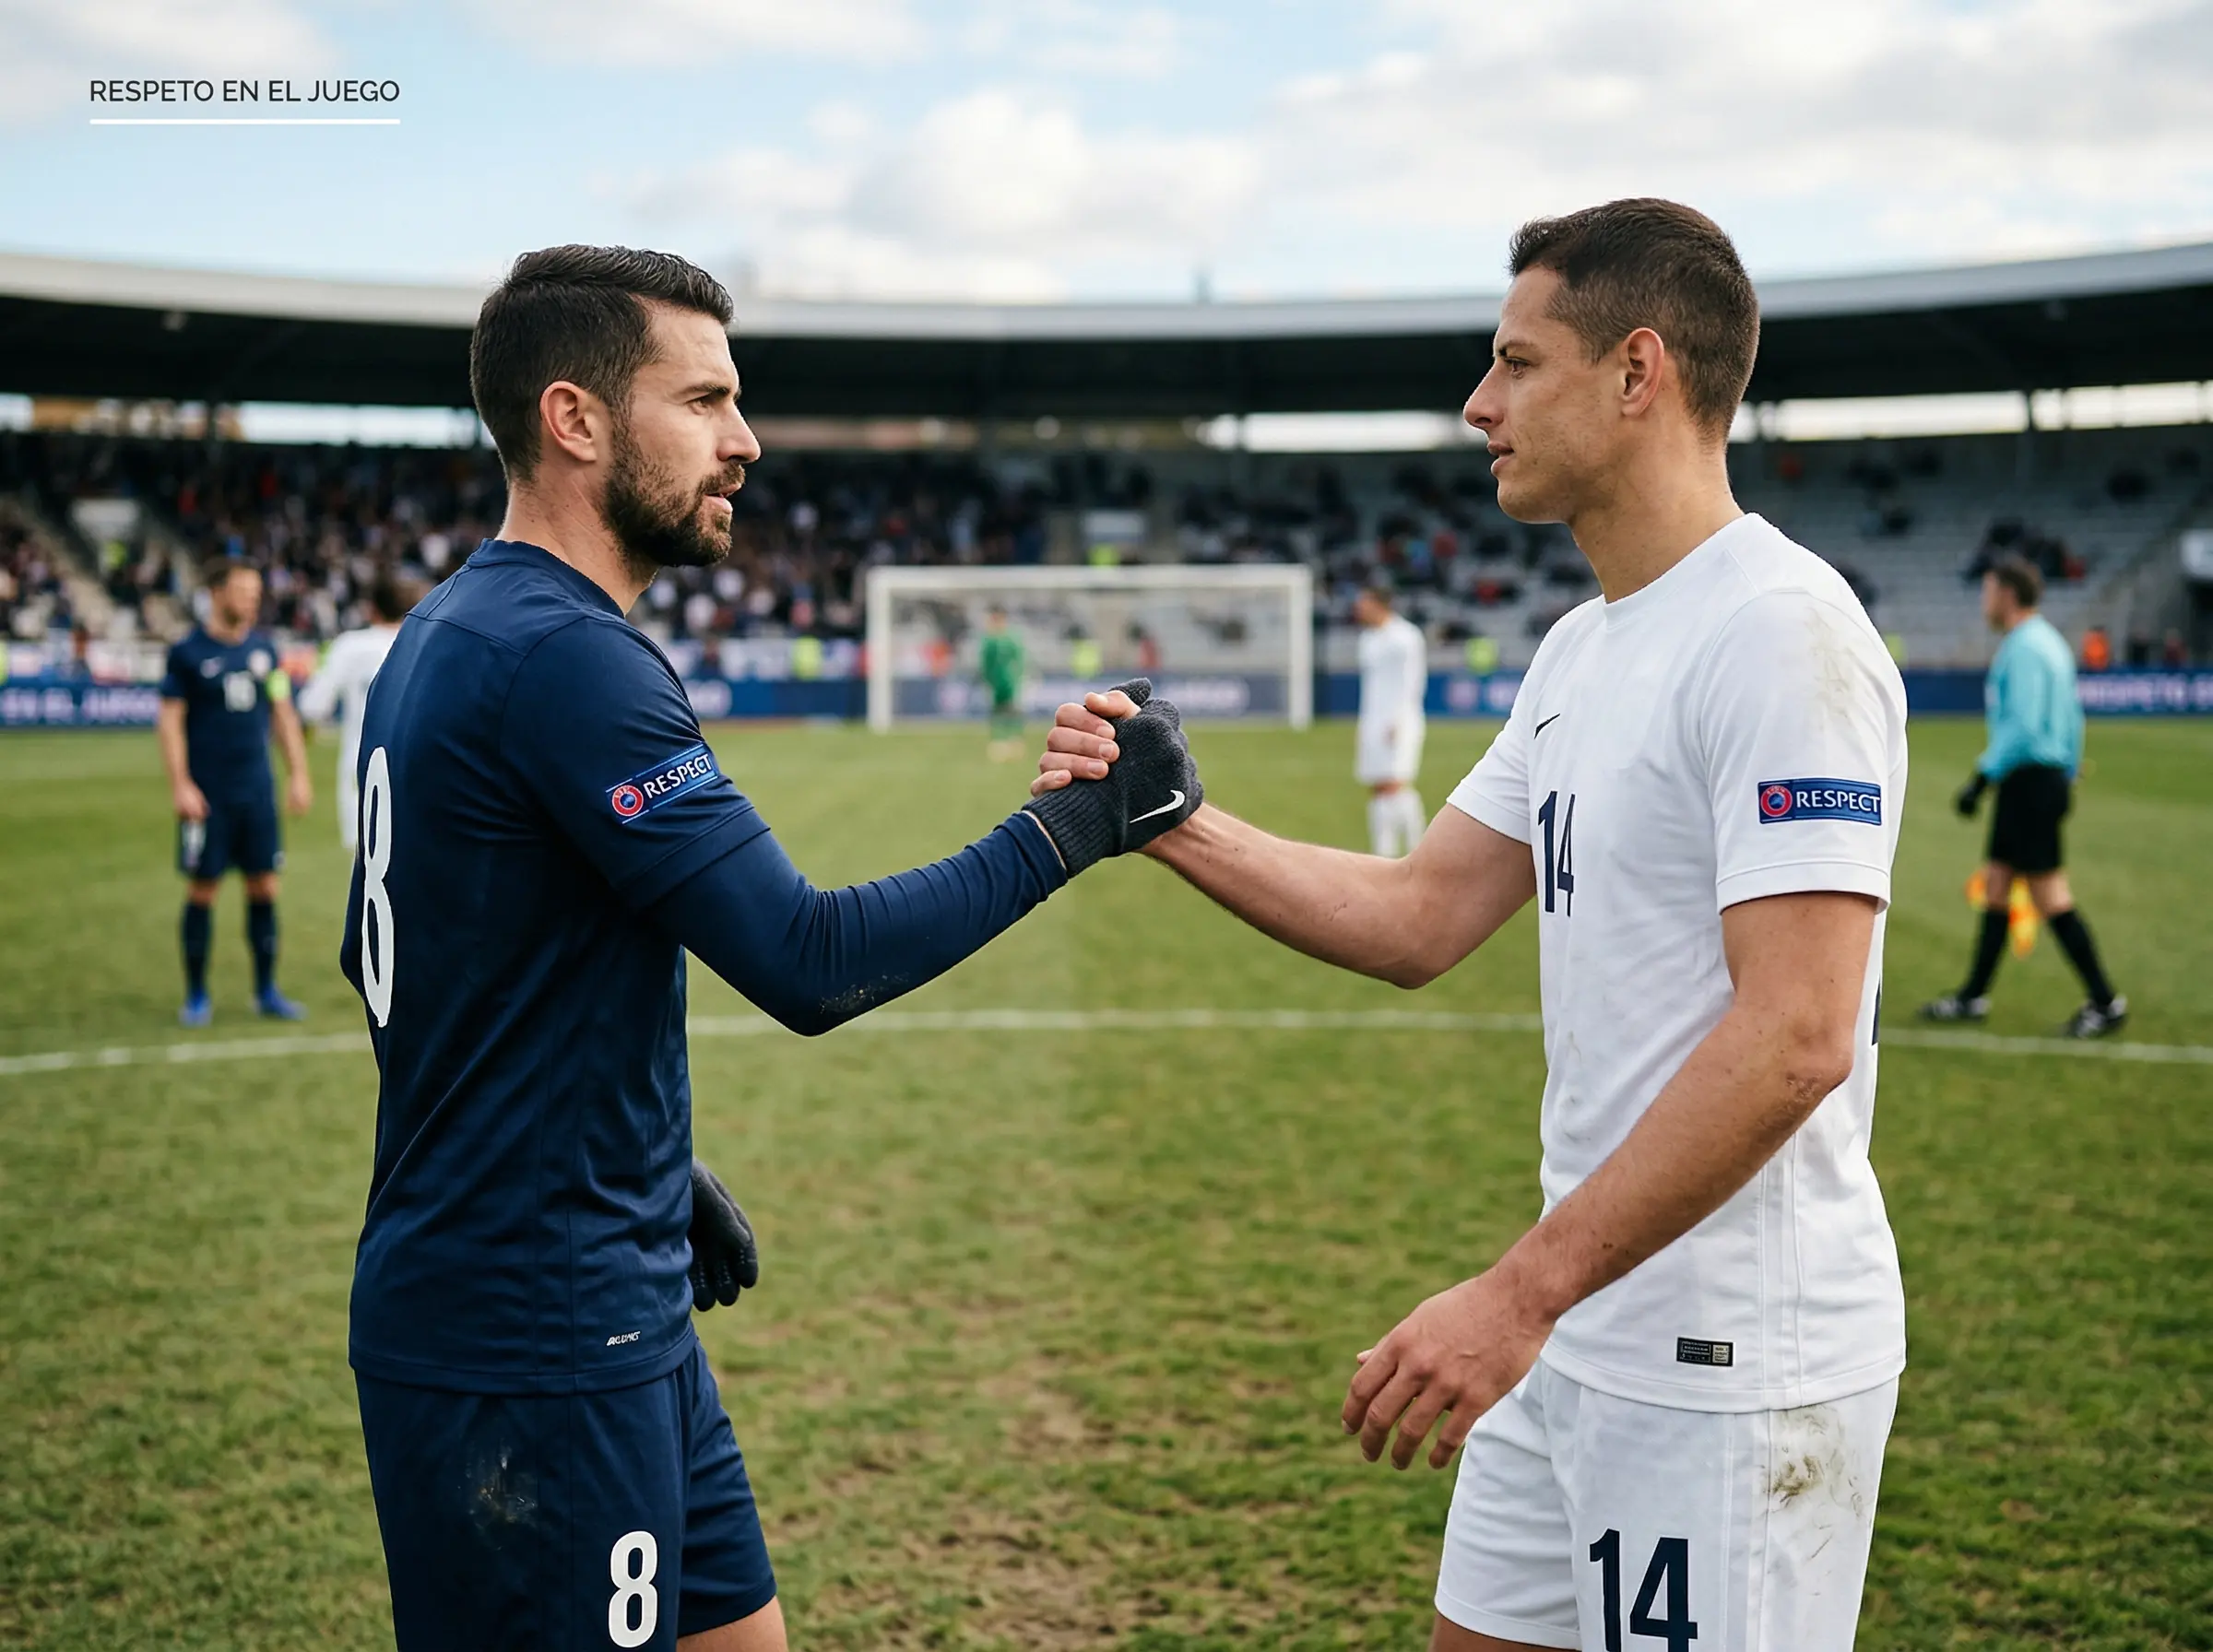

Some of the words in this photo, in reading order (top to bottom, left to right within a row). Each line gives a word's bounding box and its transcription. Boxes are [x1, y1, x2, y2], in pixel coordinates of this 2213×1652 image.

[643, 753, 713, 799] RESPECT
[1796, 790, 1881, 813] RESPECT
[362, 746, 394, 1028] 8
[1537, 790, 1576, 917] 14
[608, 1530, 658, 1648] 8
[1589, 1527, 1698, 1652] 14
